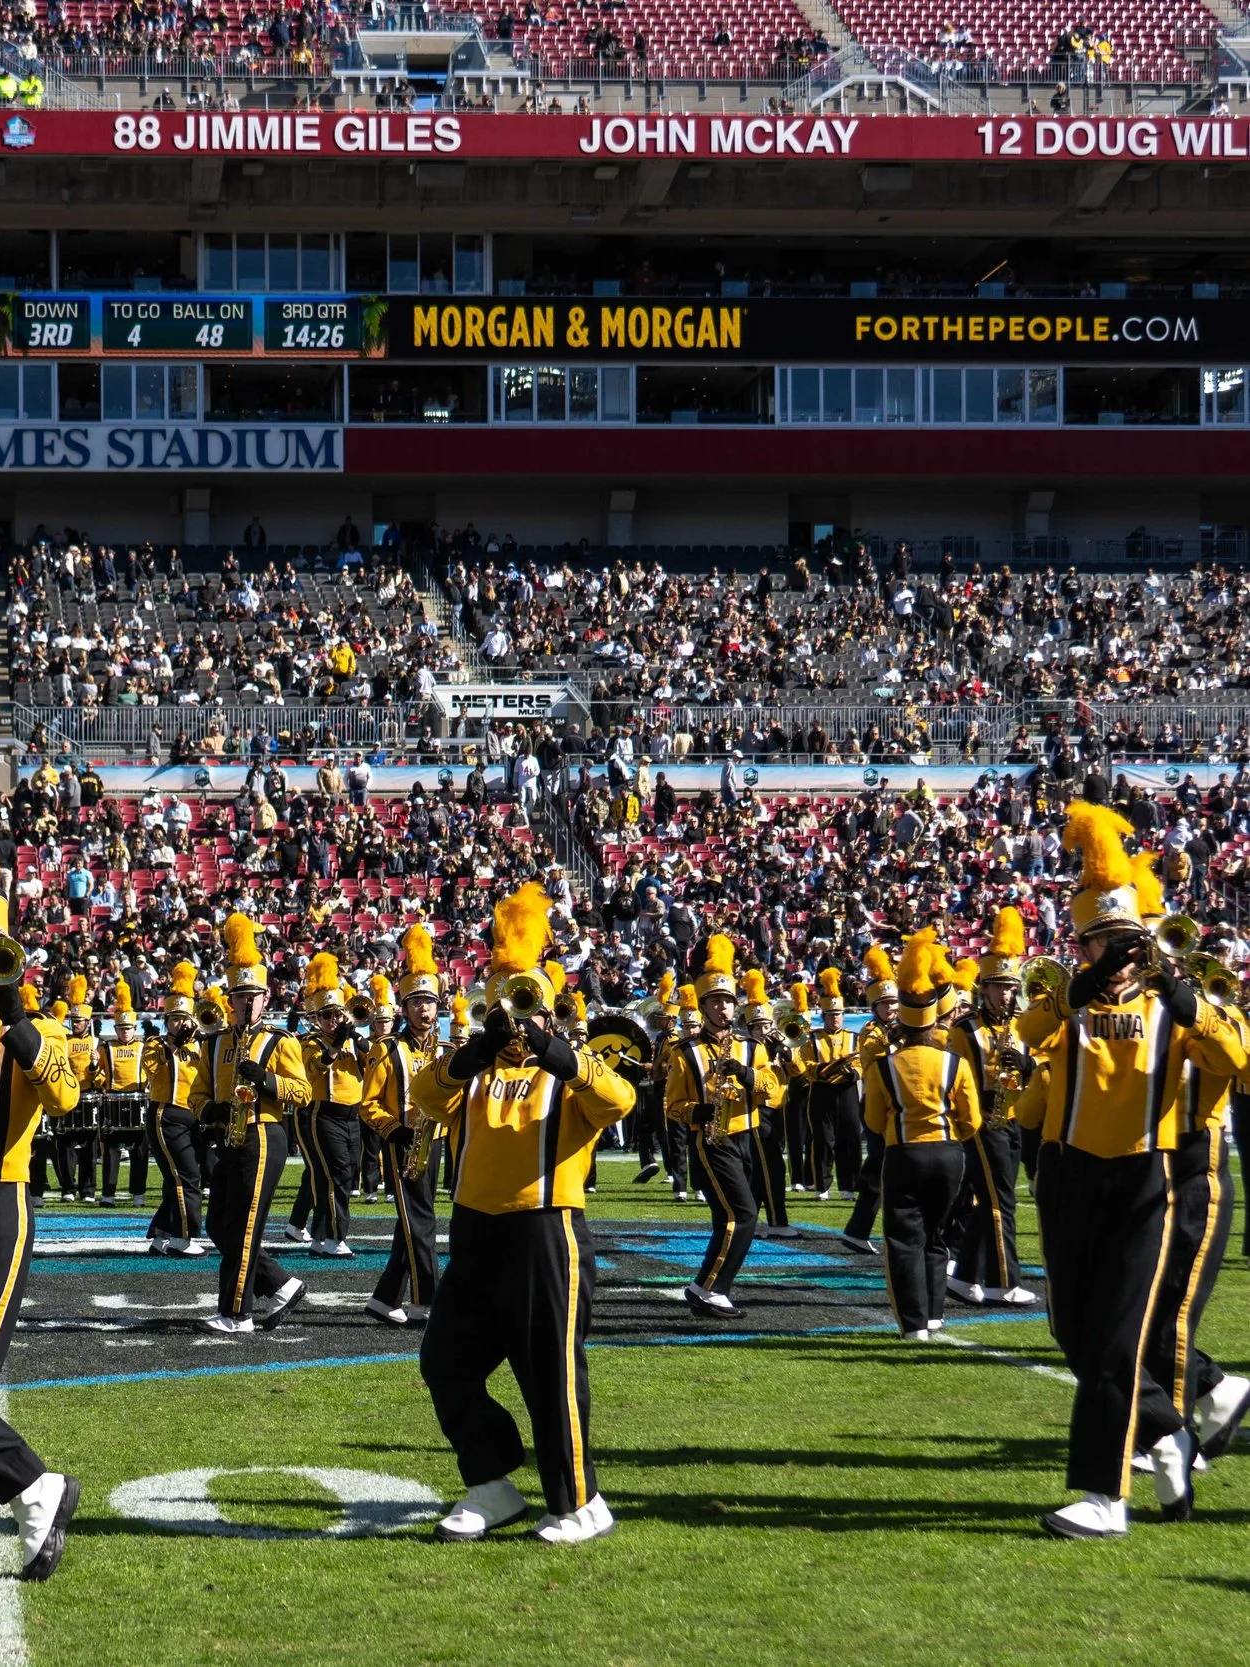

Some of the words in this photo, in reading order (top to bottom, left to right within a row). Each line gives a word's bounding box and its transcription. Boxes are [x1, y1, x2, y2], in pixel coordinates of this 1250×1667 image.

[113, 114, 162, 150] 88
[173, 114, 321, 151] JIMMIE
[334, 116, 462, 152] GILES
[579, 118, 696, 154] JOHN
[710, 118, 860, 154] MCKAY
[977, 121, 1022, 155] 12
[1035, 121, 1158, 156] DOUG
[24, 303, 78, 318] DOWN
[111, 303, 132, 318] TO
[137, 303, 161, 318] GO
[172, 303, 214, 319] BALL
[219, 303, 244, 319] ON
[282, 303, 311, 318] 3RD
[317, 303, 347, 318] QTR
[28, 323, 73, 346] 3RD
[127, 324, 141, 347] 4
[195, 324, 224, 347] 48
[282, 325, 345, 348] 14:26
[413, 306, 554, 348] MORGAN
[565, 307, 590, 348] &
[601, 307, 741, 349] MORGAN
[855, 316, 1199, 342] FORTHEPEOPLE.COM
[106, 428, 340, 469] STADIUM
[452, 694, 553, 709] METERS
[1090, 1012, 1144, 1040] IOWA
[72, 1042, 90, 1052] IOWA
[116, 1046, 135, 1058] IOWA
[485, 1077, 532, 1101] IOWA
